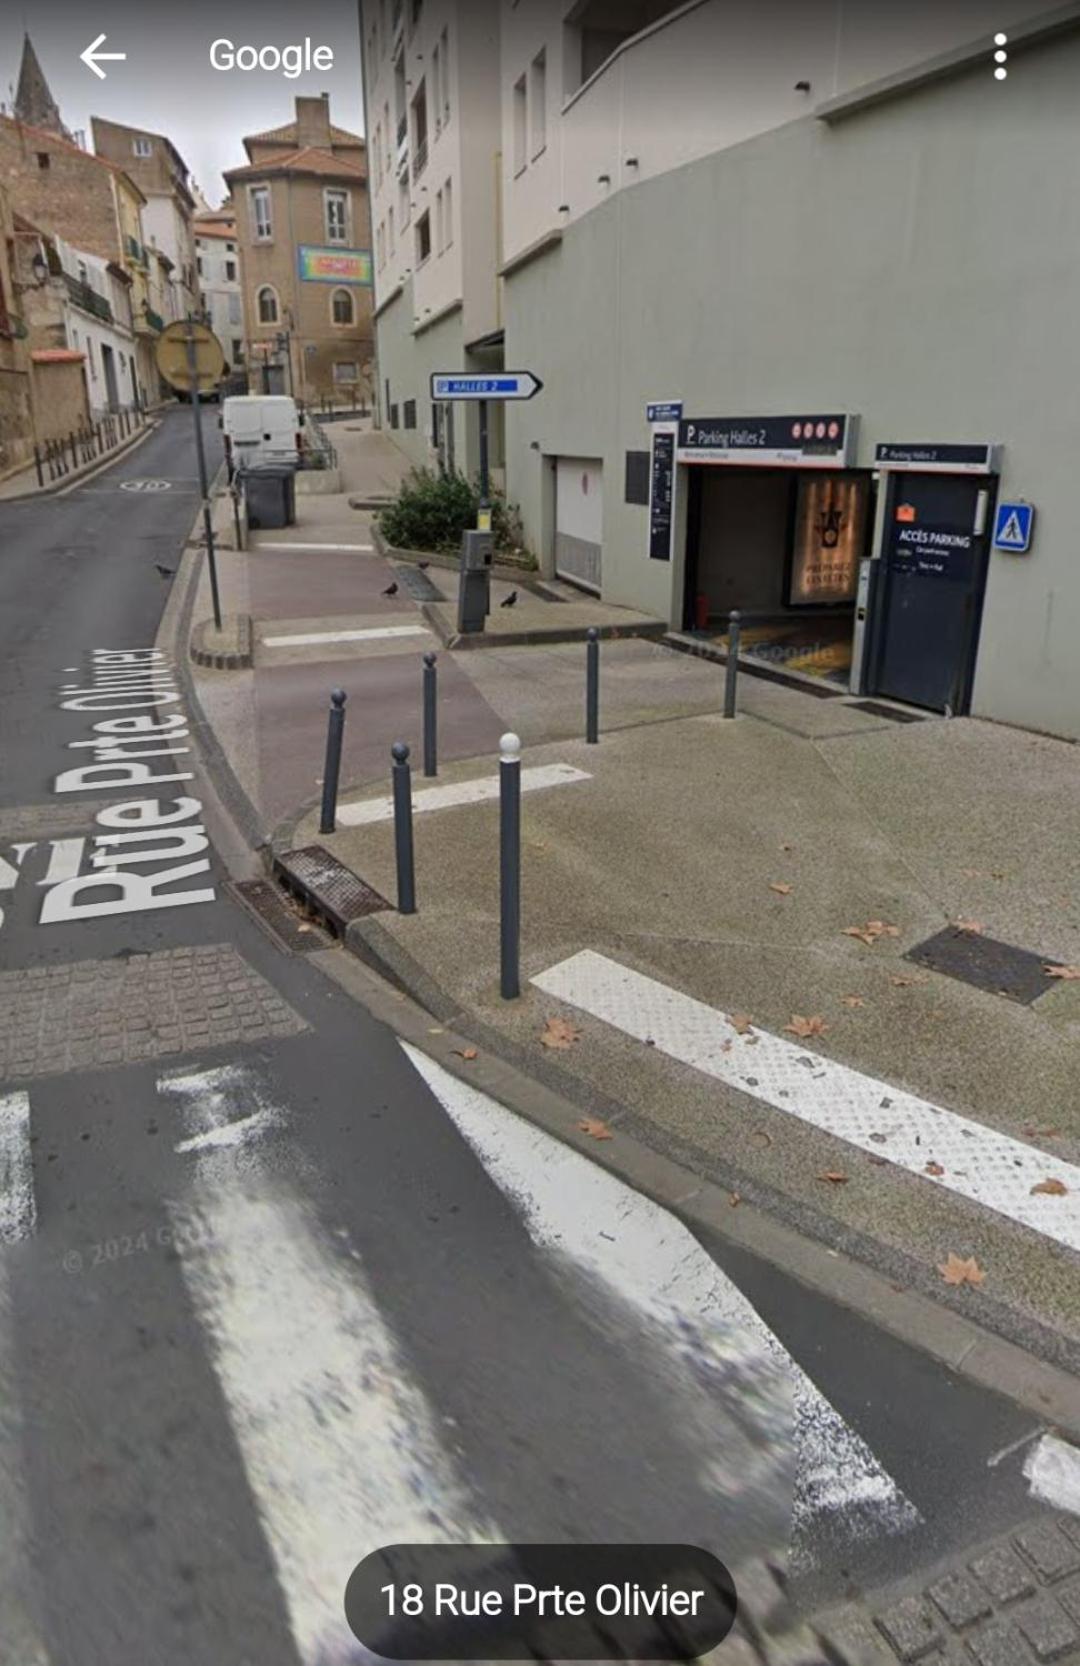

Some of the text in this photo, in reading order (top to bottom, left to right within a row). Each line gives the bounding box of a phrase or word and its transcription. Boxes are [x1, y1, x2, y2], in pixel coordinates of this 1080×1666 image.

[699, 430, 729, 448] Parking
[730, 430, 758, 446] Halles
[759, 430, 766, 445] 2
[900, 528, 970, 548] ACCÈS PARKING
